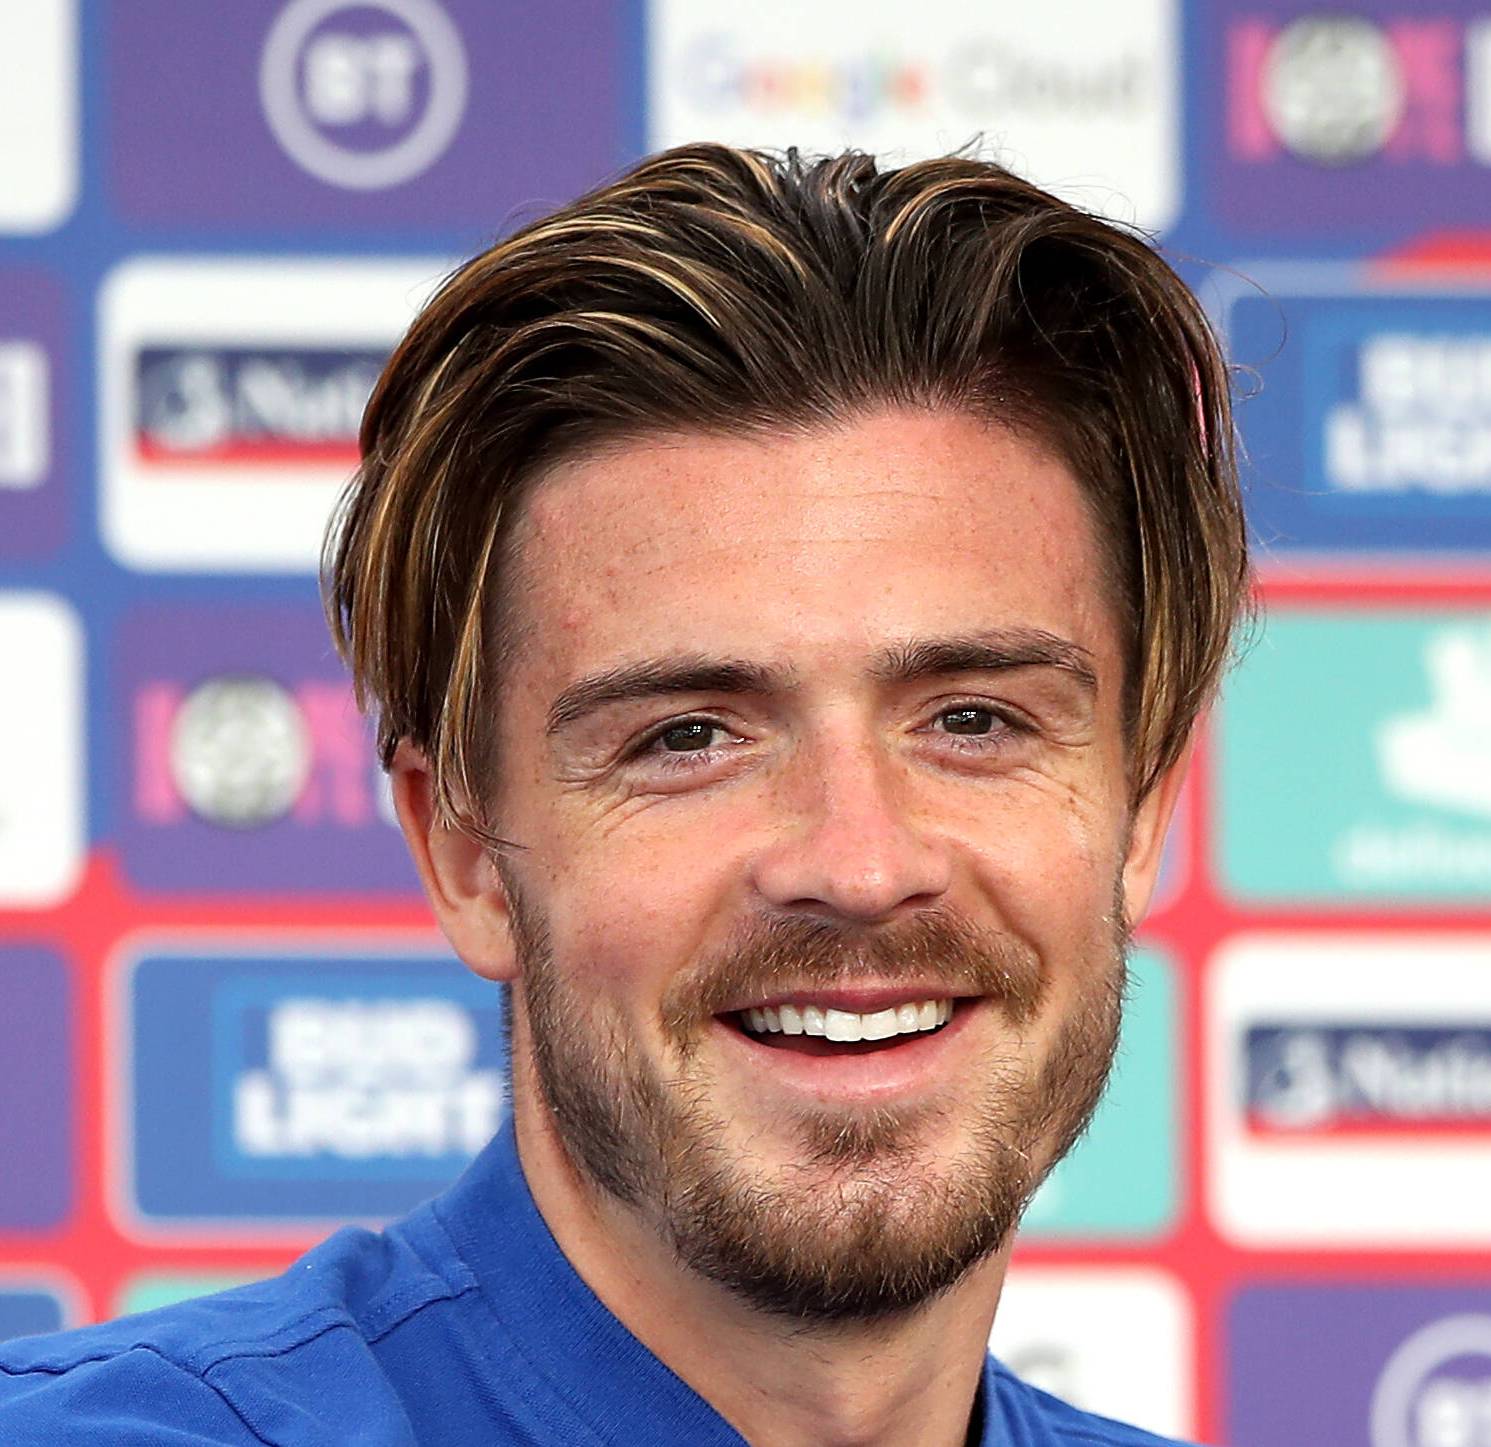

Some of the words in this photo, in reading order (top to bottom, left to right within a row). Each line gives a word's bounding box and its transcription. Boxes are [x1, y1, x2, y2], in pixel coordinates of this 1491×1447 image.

[306, 36, 412, 126] BT
[682, 34, 931, 114] Google
[269, 1000, 476, 1072] BUD
[234, 1070, 505, 1155] LIGHT
